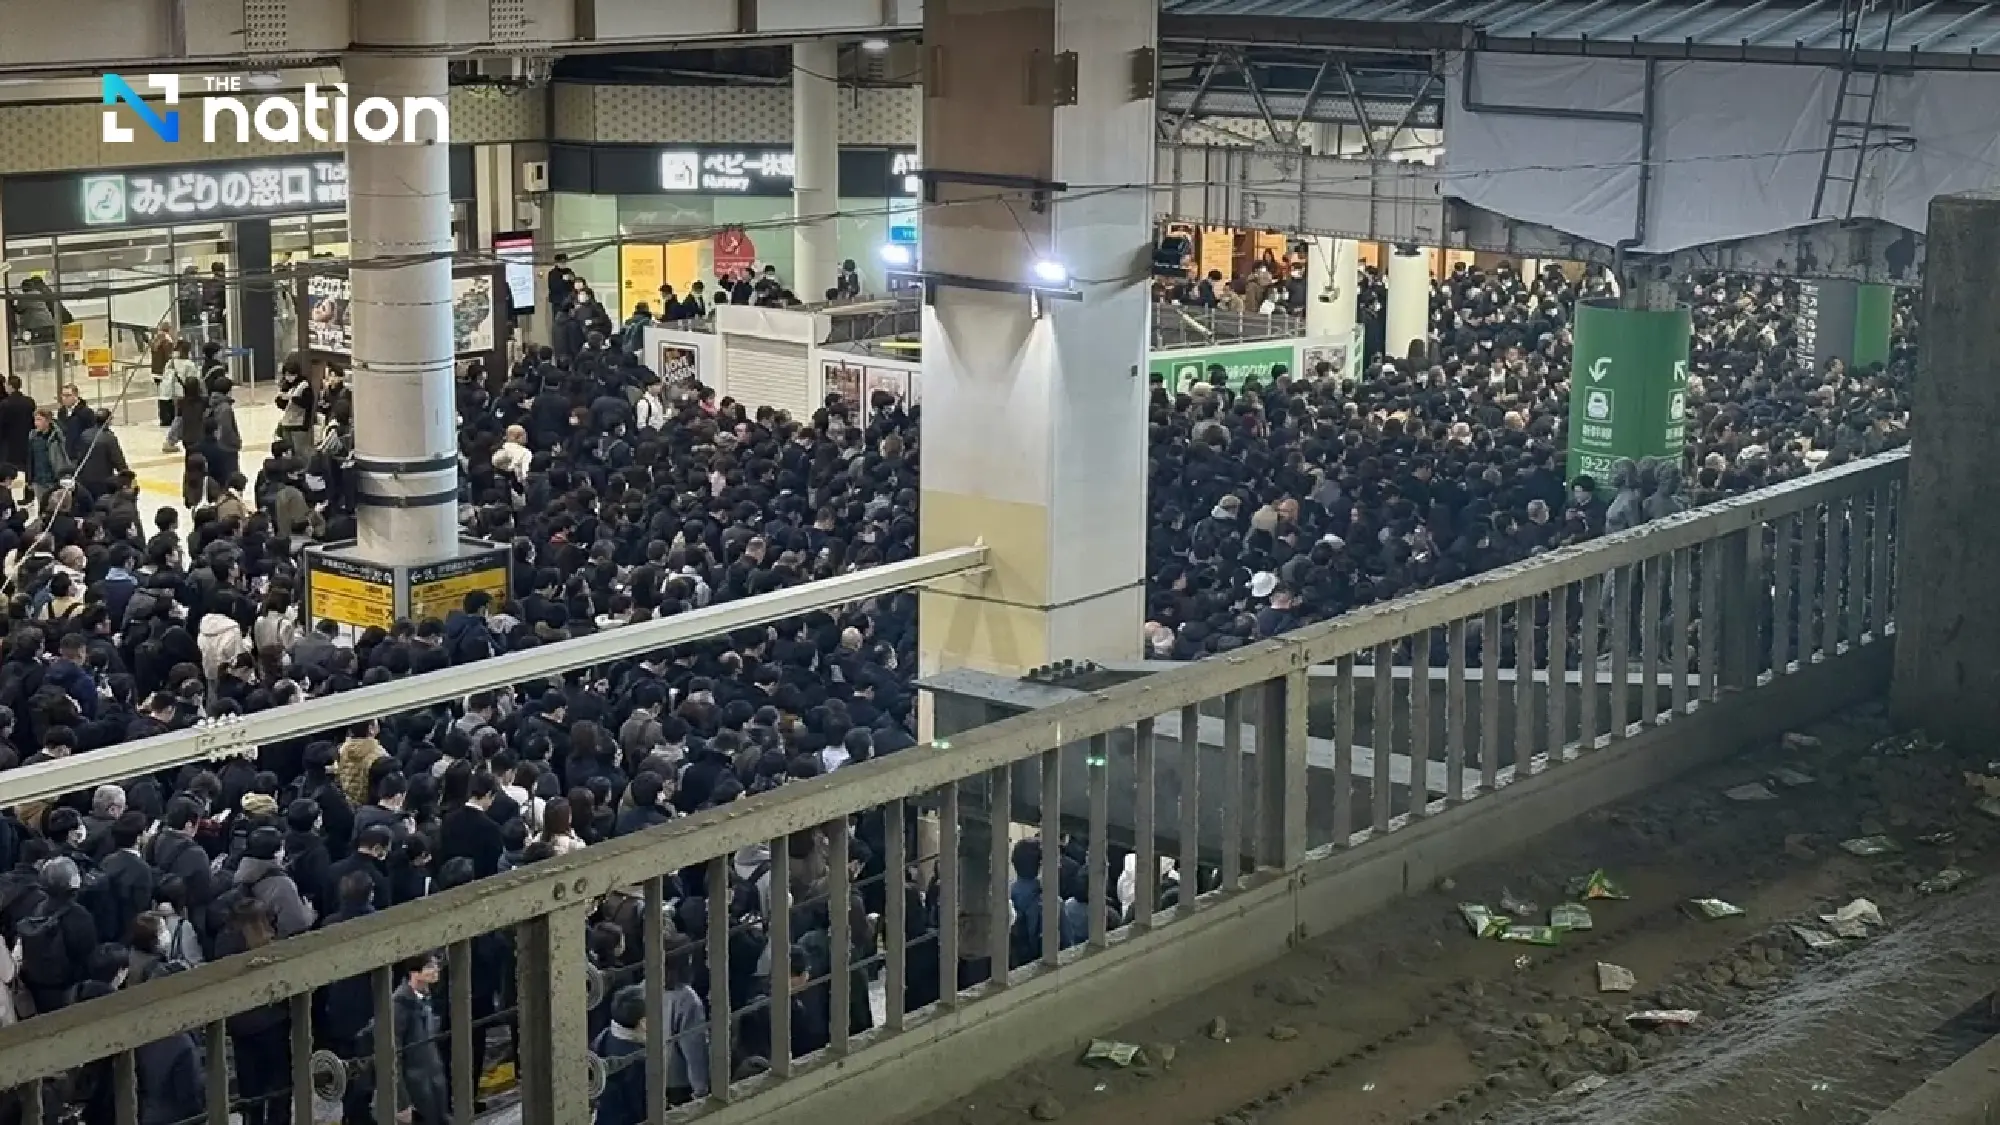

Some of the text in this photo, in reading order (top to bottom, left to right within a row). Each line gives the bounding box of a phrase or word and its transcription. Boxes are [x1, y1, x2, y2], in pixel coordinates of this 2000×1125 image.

[130, 166, 312, 215] みどりの窓口
